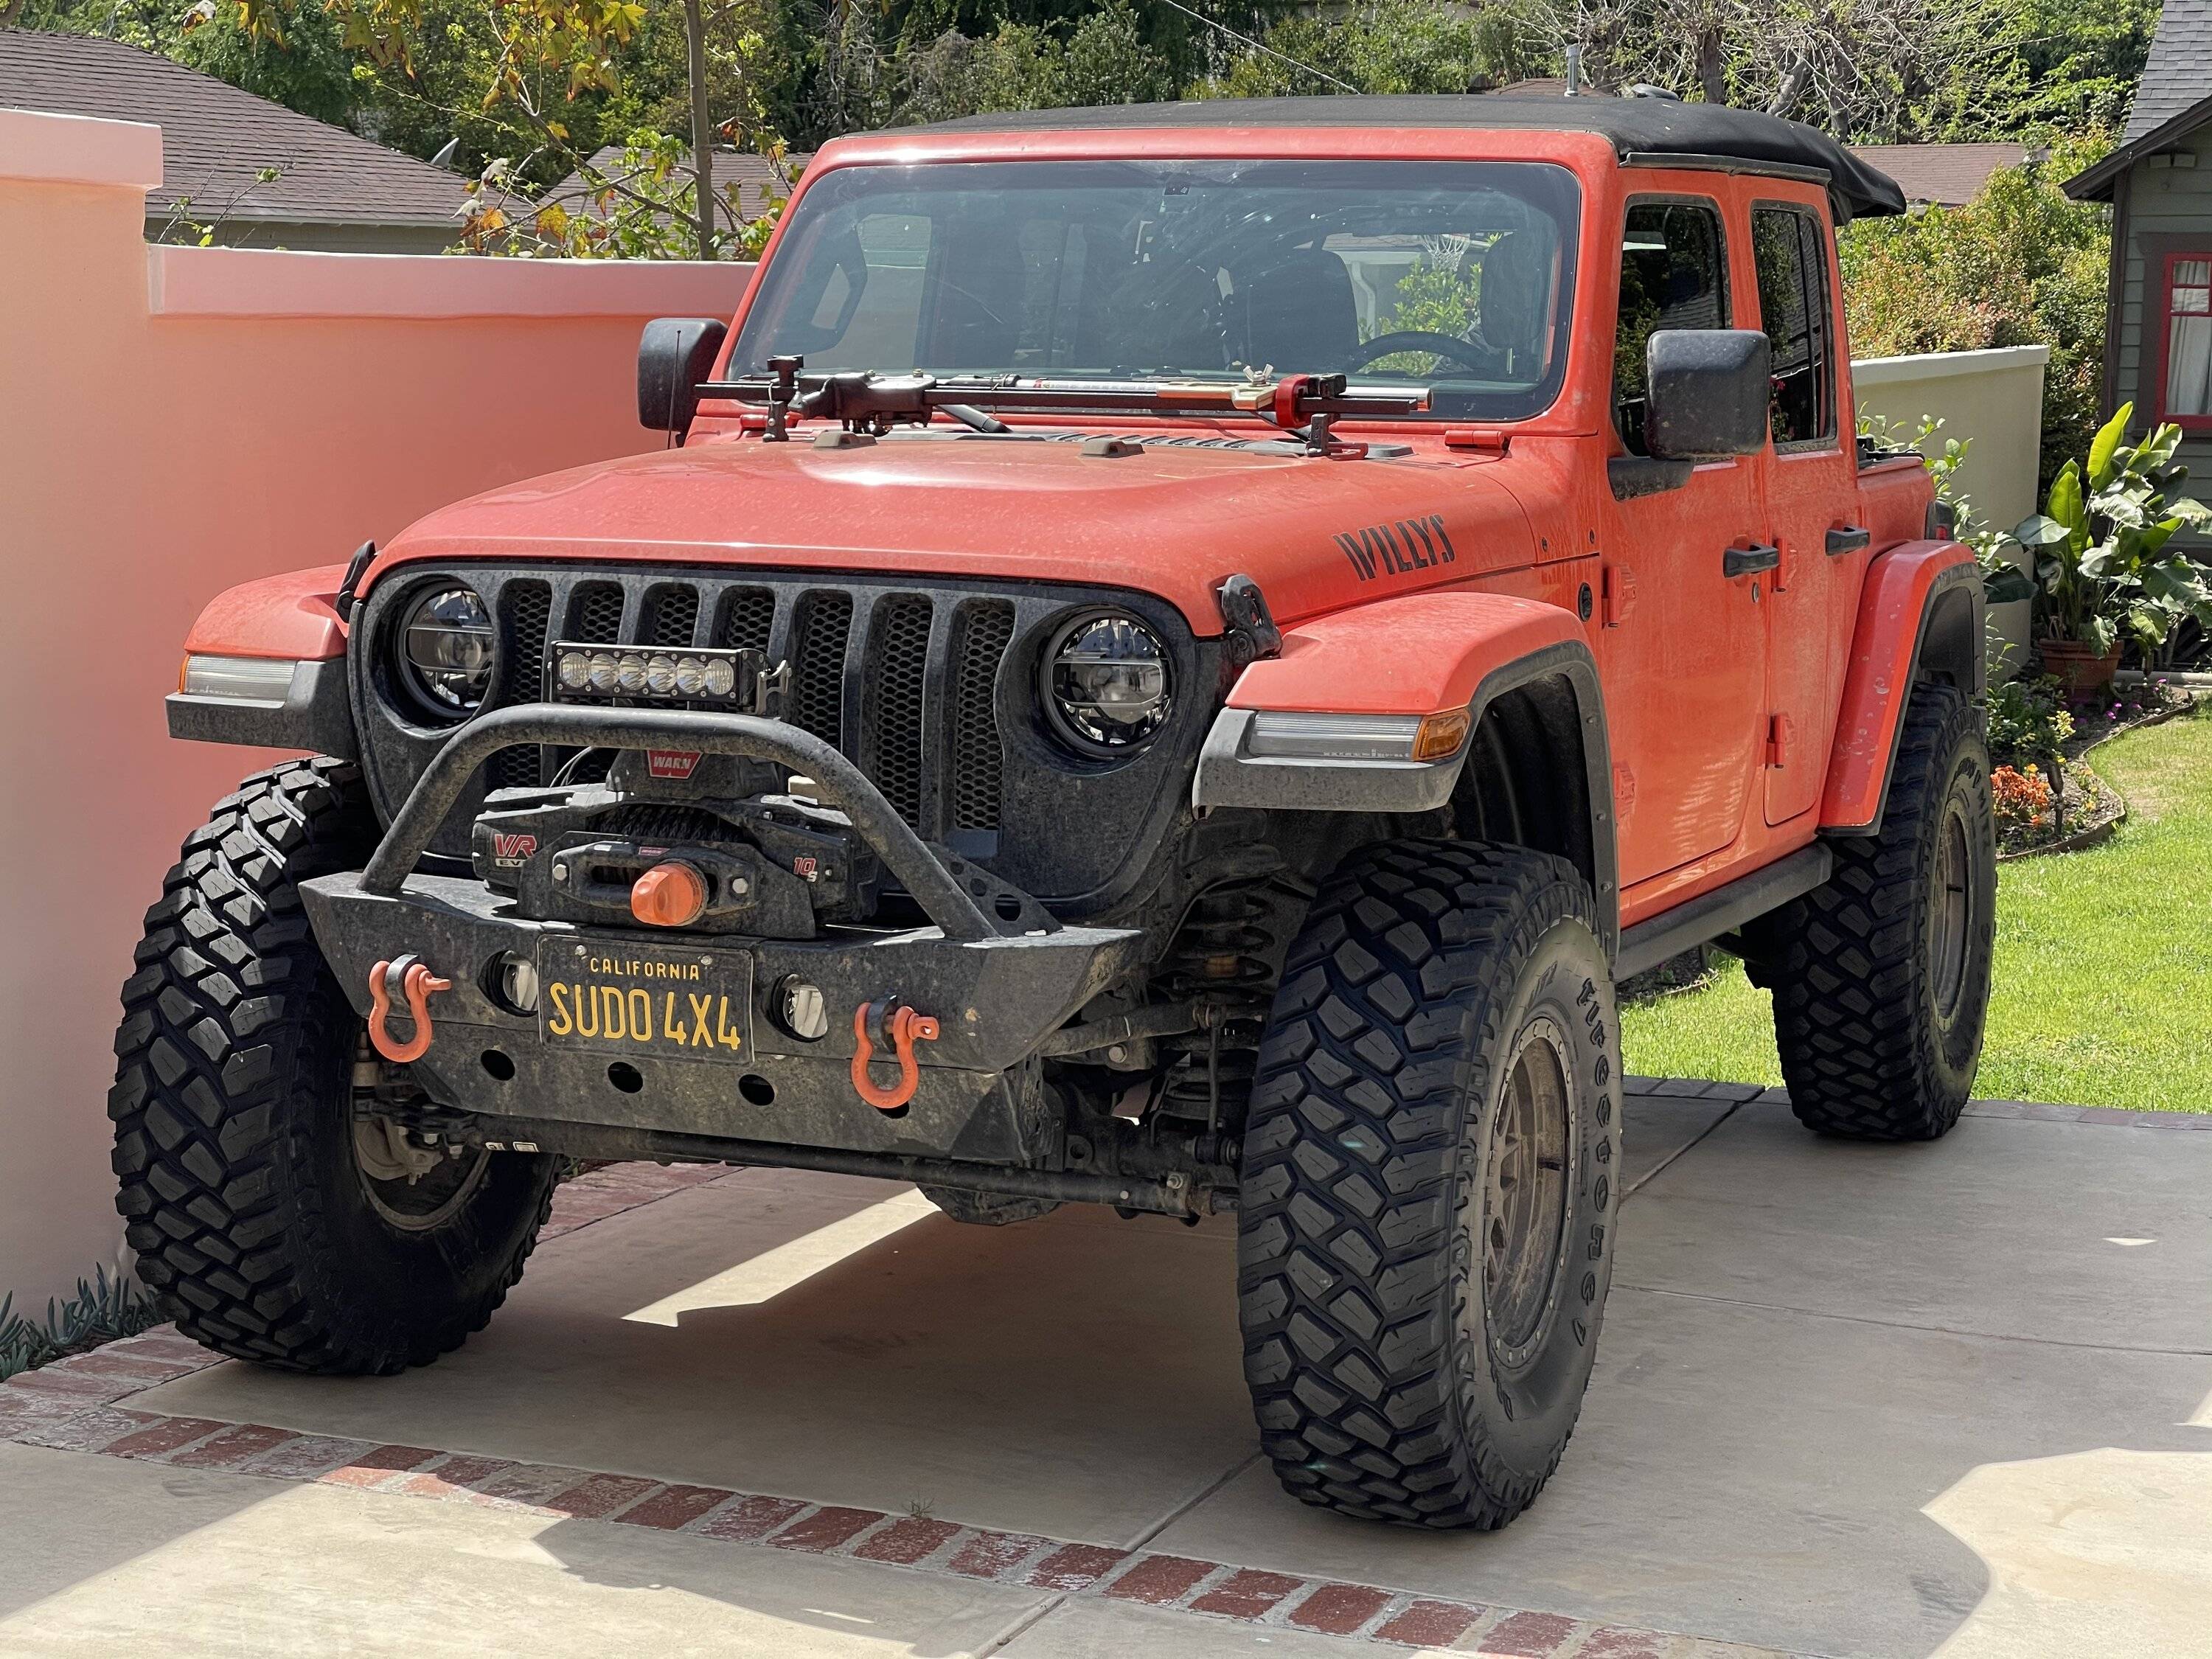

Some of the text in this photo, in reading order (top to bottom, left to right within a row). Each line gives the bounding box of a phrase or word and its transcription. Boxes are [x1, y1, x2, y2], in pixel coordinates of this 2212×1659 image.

[1332, 514, 1455, 581] WILLYS
[653, 757, 692, 769] WARN
[495, 834, 538, 857] VR
[591, 958, 699, 981] CALIFORNIA
[549, 982, 740, 1050] SUDO 4X4
